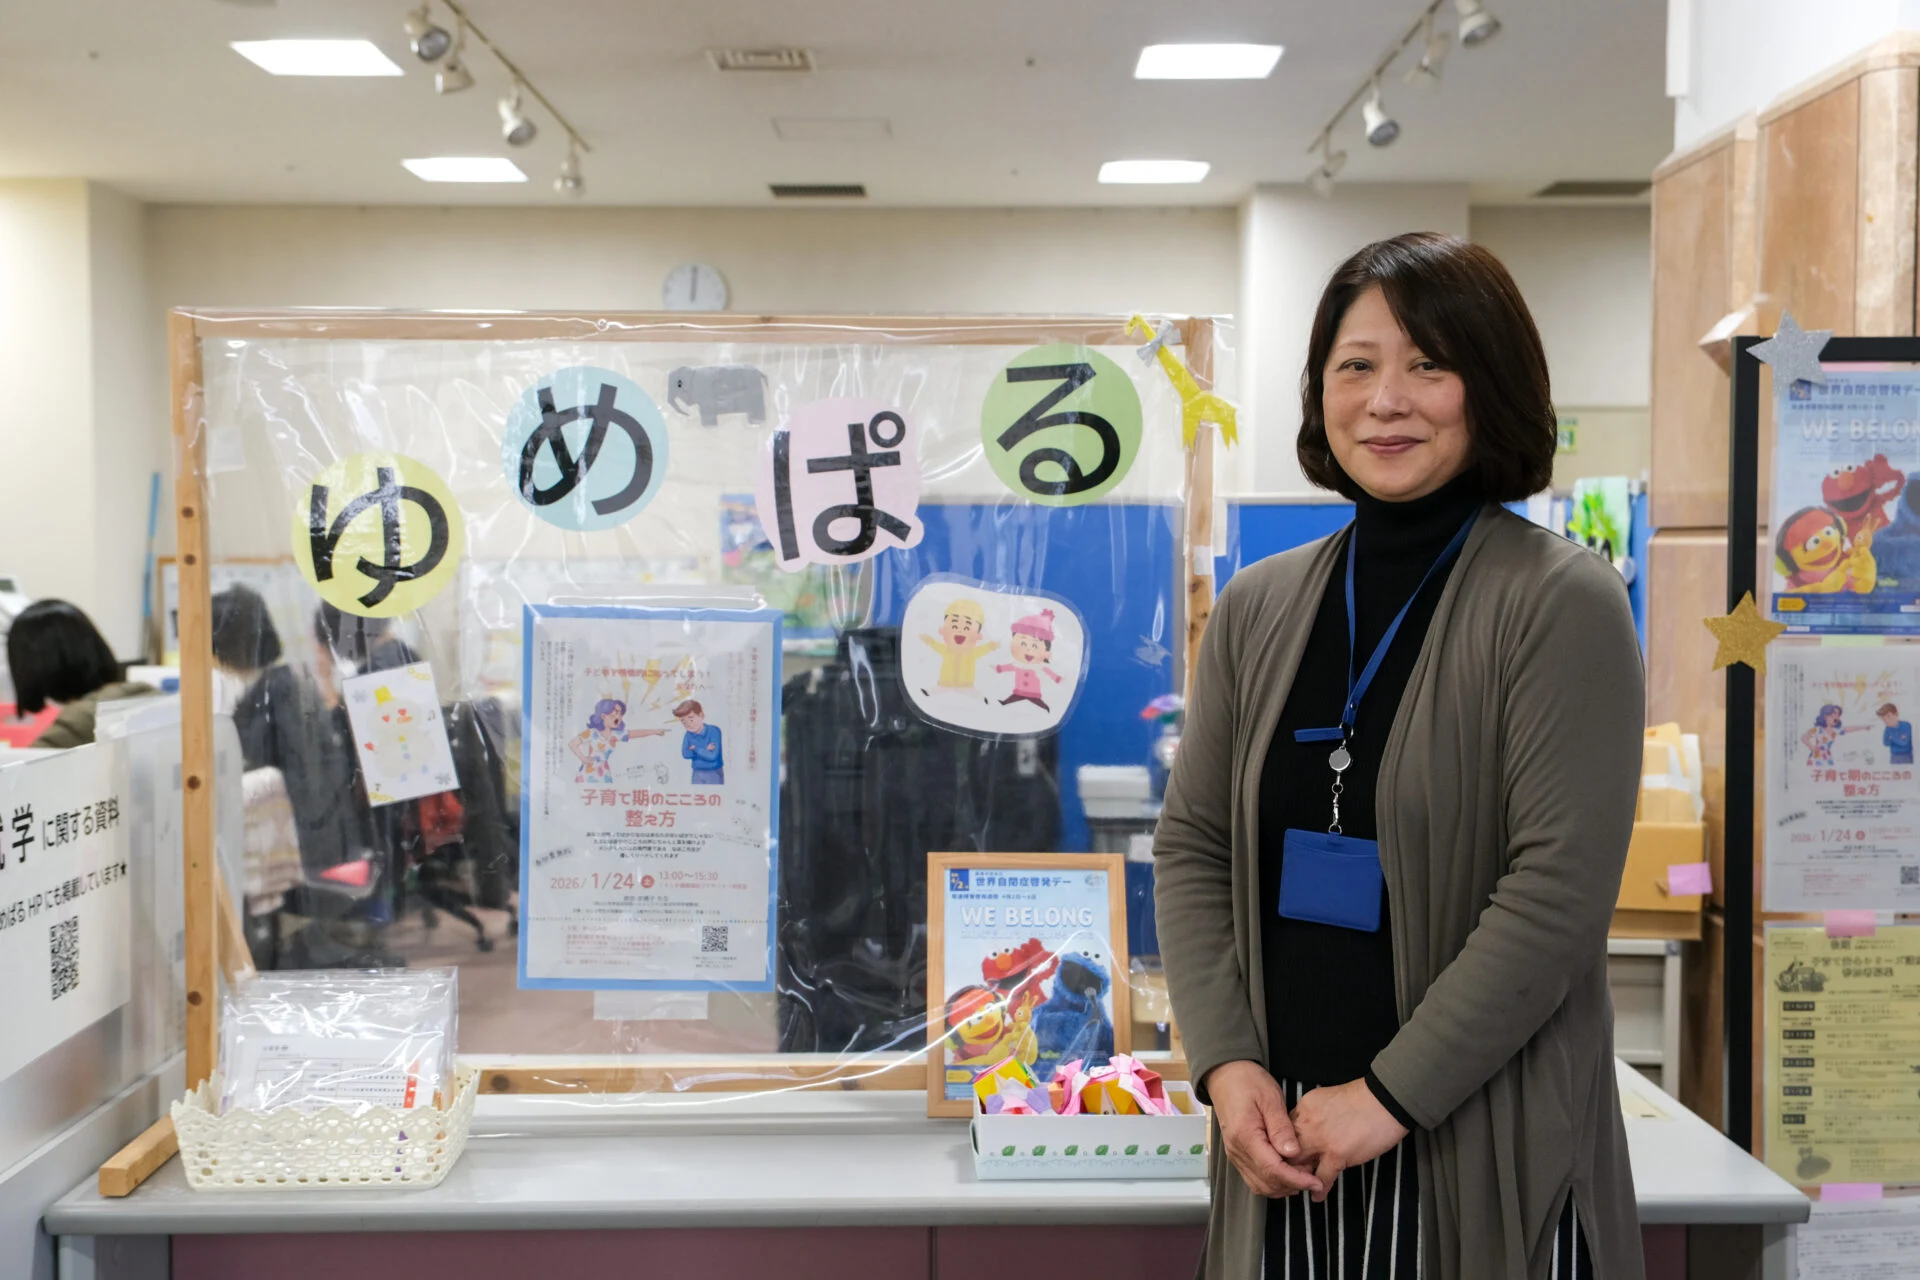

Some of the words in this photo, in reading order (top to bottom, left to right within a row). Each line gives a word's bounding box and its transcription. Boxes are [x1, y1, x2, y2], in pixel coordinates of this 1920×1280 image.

[1802, 418, 1840, 441] WE
[1811, 769, 1912, 782] 子育て期のこころの
[580, 788, 722, 807] 子育て期のこころの
[1842, 784, 1880, 796] 整え方
[625, 810, 677, 828] 整え方
[591, 872, 634, 891] 1/24
[975, 876, 1072, 888] 世界自閉症啓発デー
[961, 906, 996, 927] WE
[1005, 906, 1094, 927] BELONG
